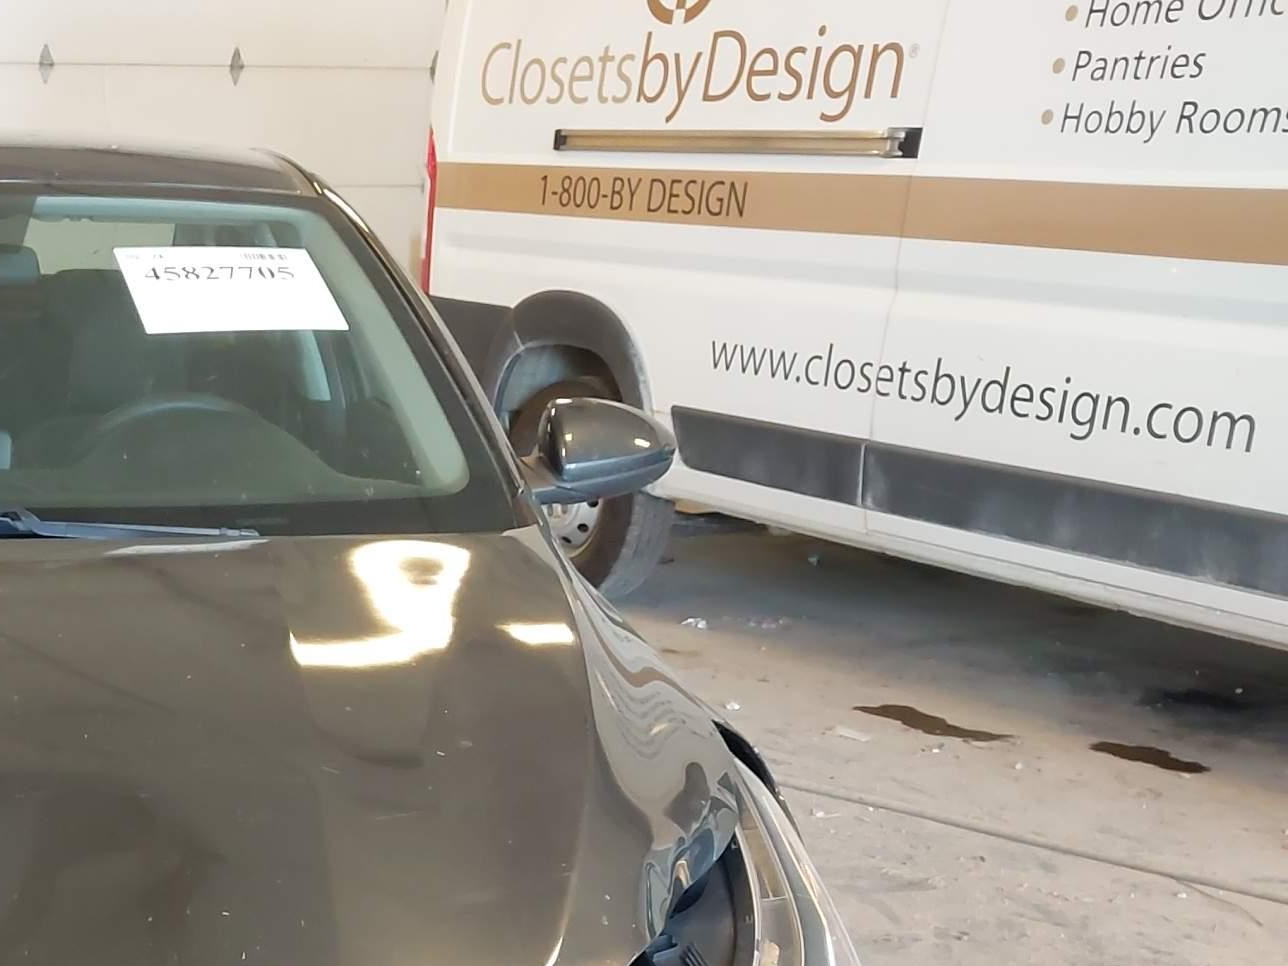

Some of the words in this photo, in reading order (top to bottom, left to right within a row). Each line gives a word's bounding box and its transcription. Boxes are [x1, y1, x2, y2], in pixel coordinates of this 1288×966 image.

[1085, 0, 1184, 28] Home
[1072, 45, 1206, 82] Pantries
[1061, 100, 1166, 144] Hobby
[539, 174, 642, 211] 1-800-BY
[646, 178, 748, 218] DESIGN
[144, 265, 295, 281] 45827705
[710, 340, 1257, 453] www.closetsbydesign.com
